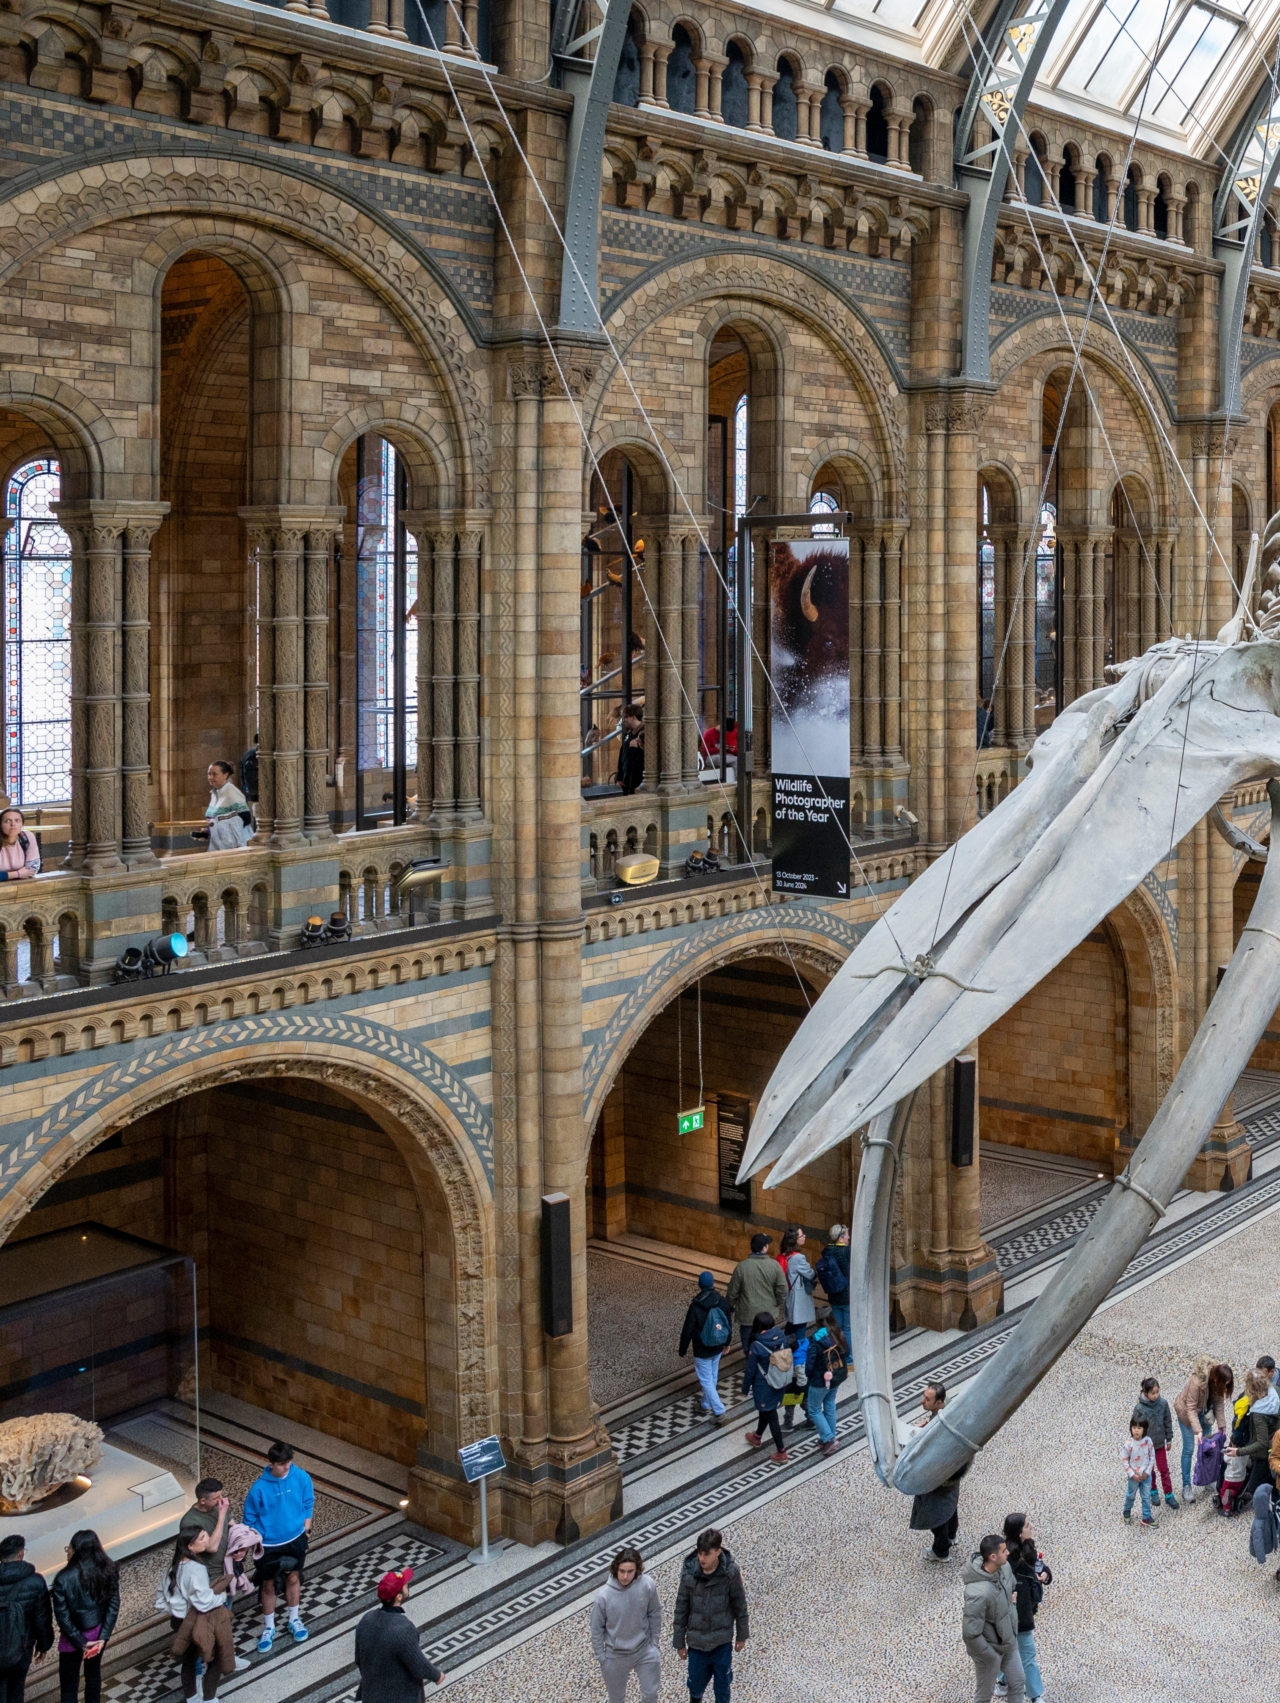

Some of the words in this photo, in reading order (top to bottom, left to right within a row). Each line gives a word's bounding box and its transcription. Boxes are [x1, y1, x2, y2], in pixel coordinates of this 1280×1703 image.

[775, 779, 812, 792] Wildlife
[775, 793, 845, 809] Photographer
[775, 807, 786, 819] of
[788, 808, 804, 821] the
[805, 809, 829, 823] Year
[782, 871, 802, 880] October
